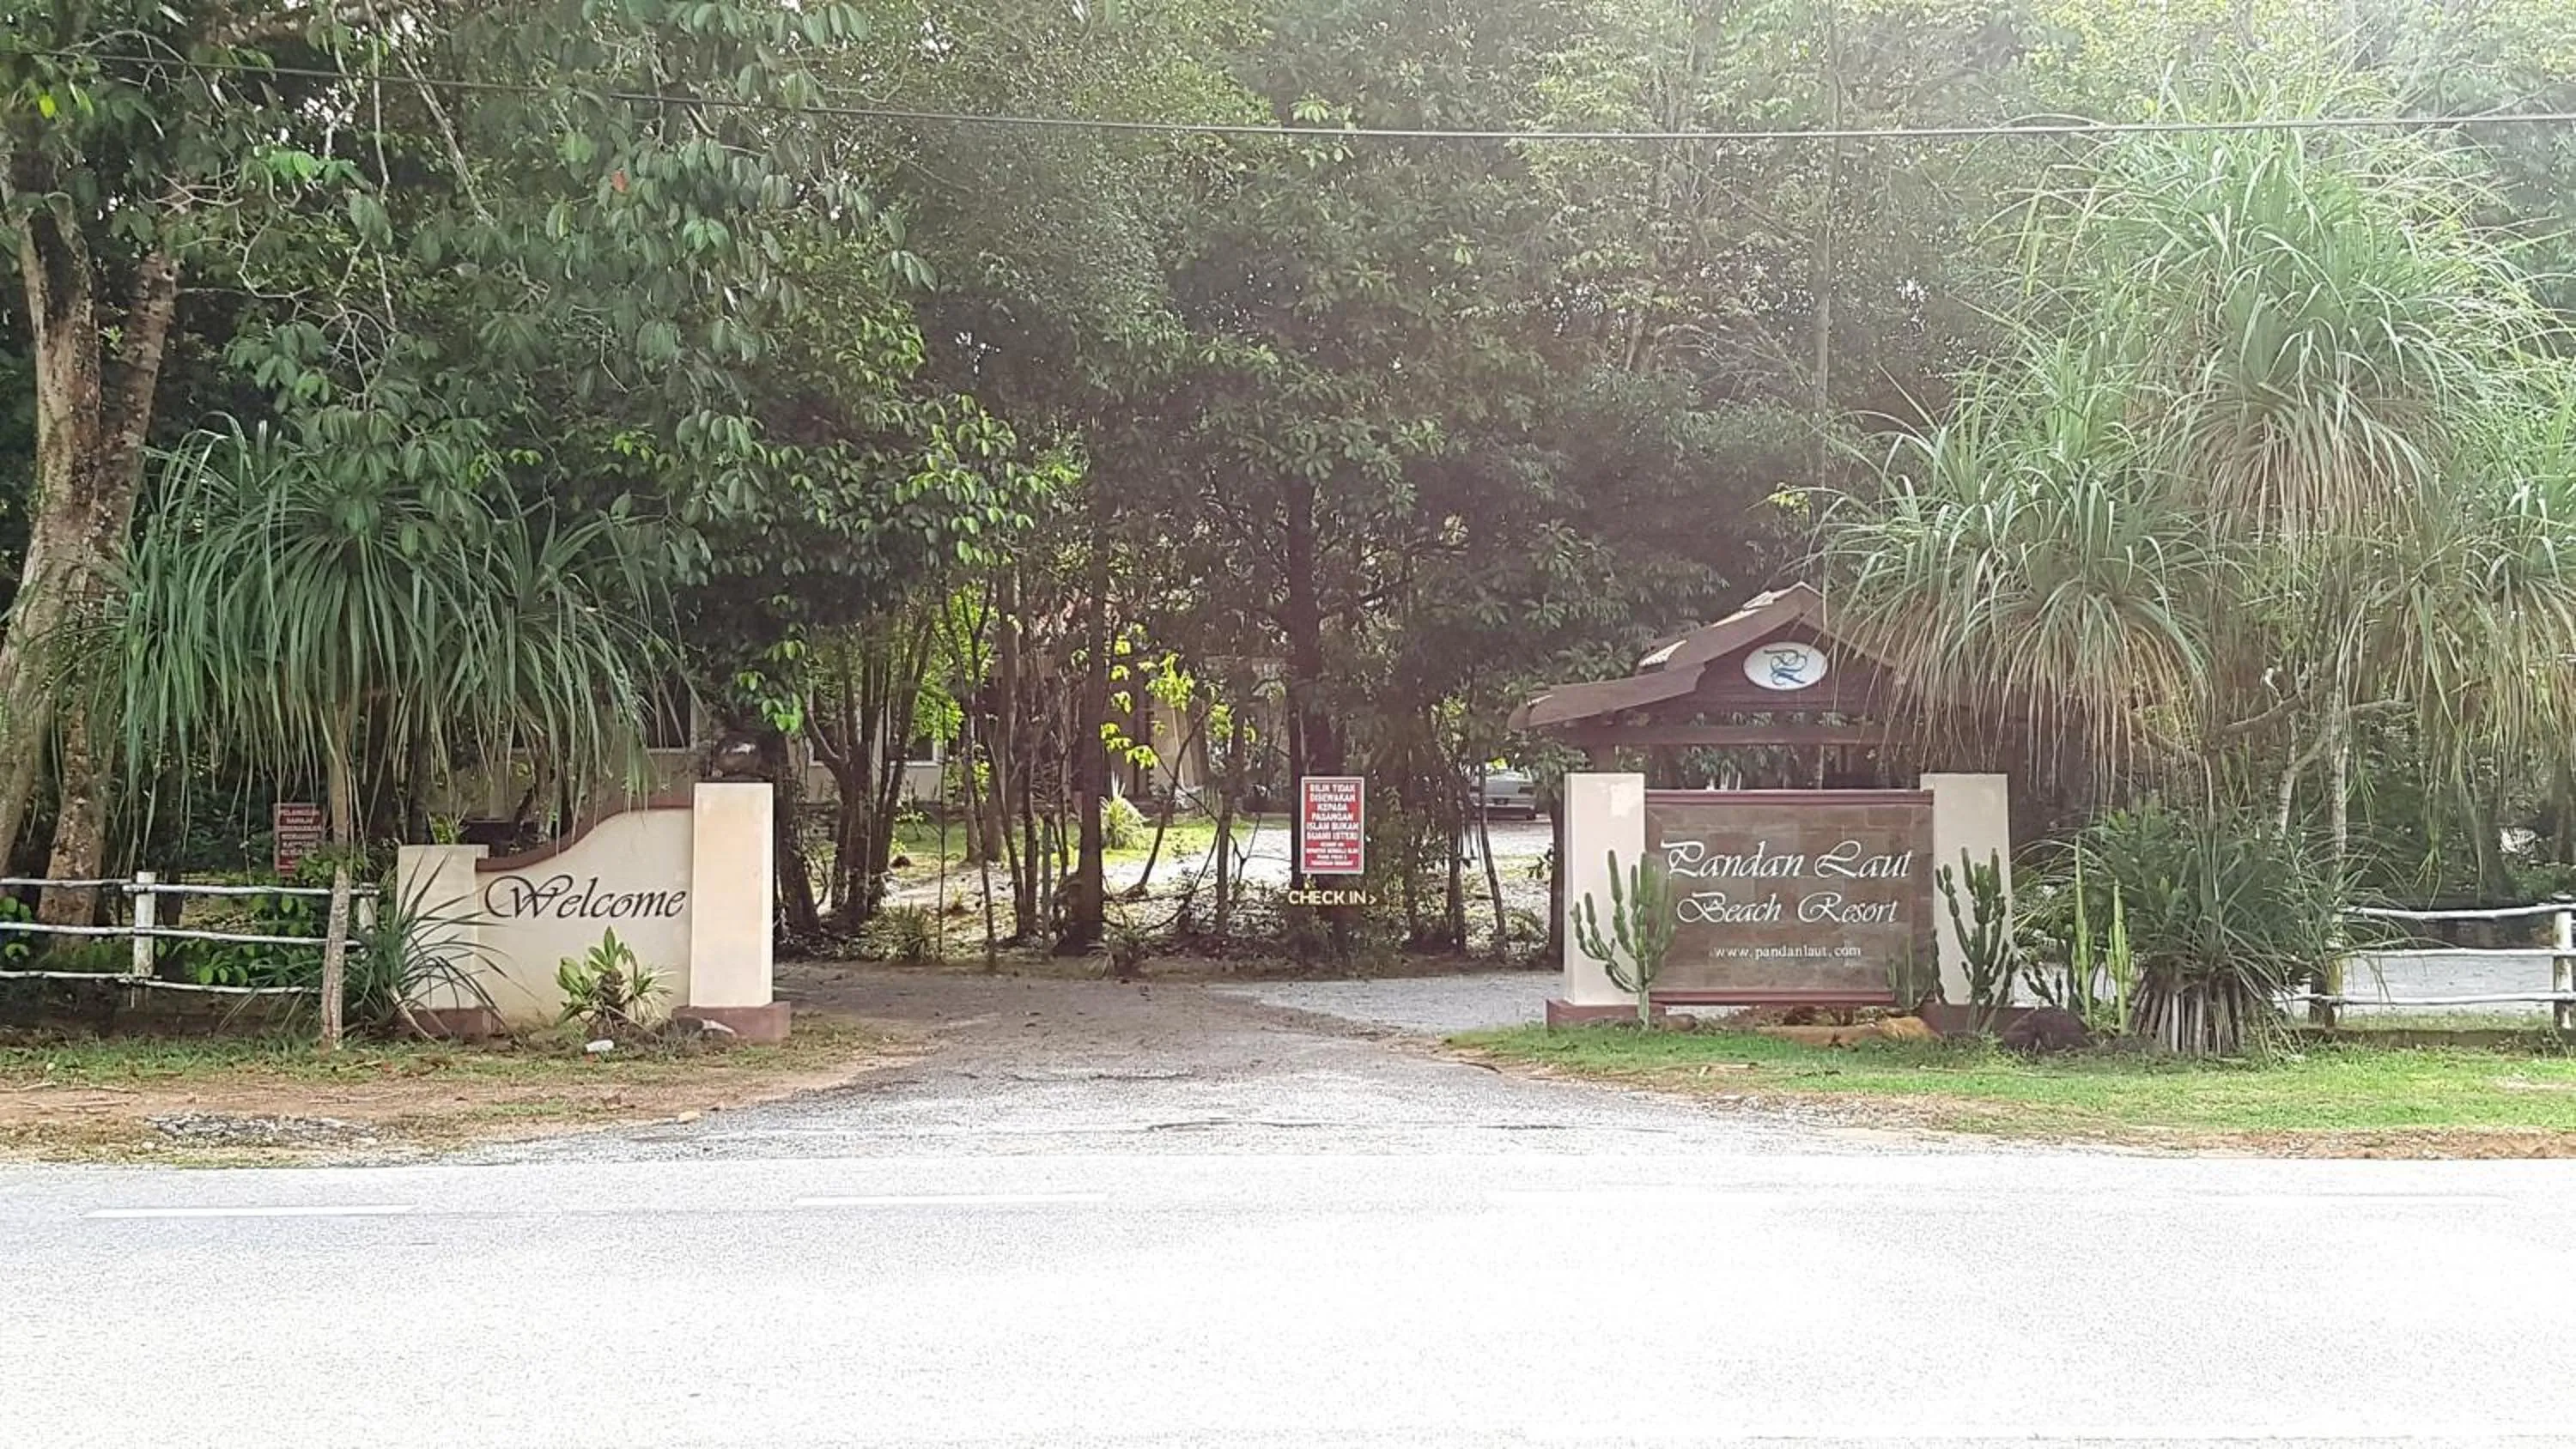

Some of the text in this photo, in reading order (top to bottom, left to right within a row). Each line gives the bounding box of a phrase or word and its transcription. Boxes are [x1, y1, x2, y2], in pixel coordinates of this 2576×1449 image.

[1332, 784, 1356, 792] TIDAK
[1660, 840, 1913, 878] Pandan Laut
[484, 874, 687, 919] Welcome
[1288, 890, 1346, 905] CHECK
[1677, 892, 1899, 924] Beach Resort
[1715, 944, 1862, 961] www.pandanlaut.com
